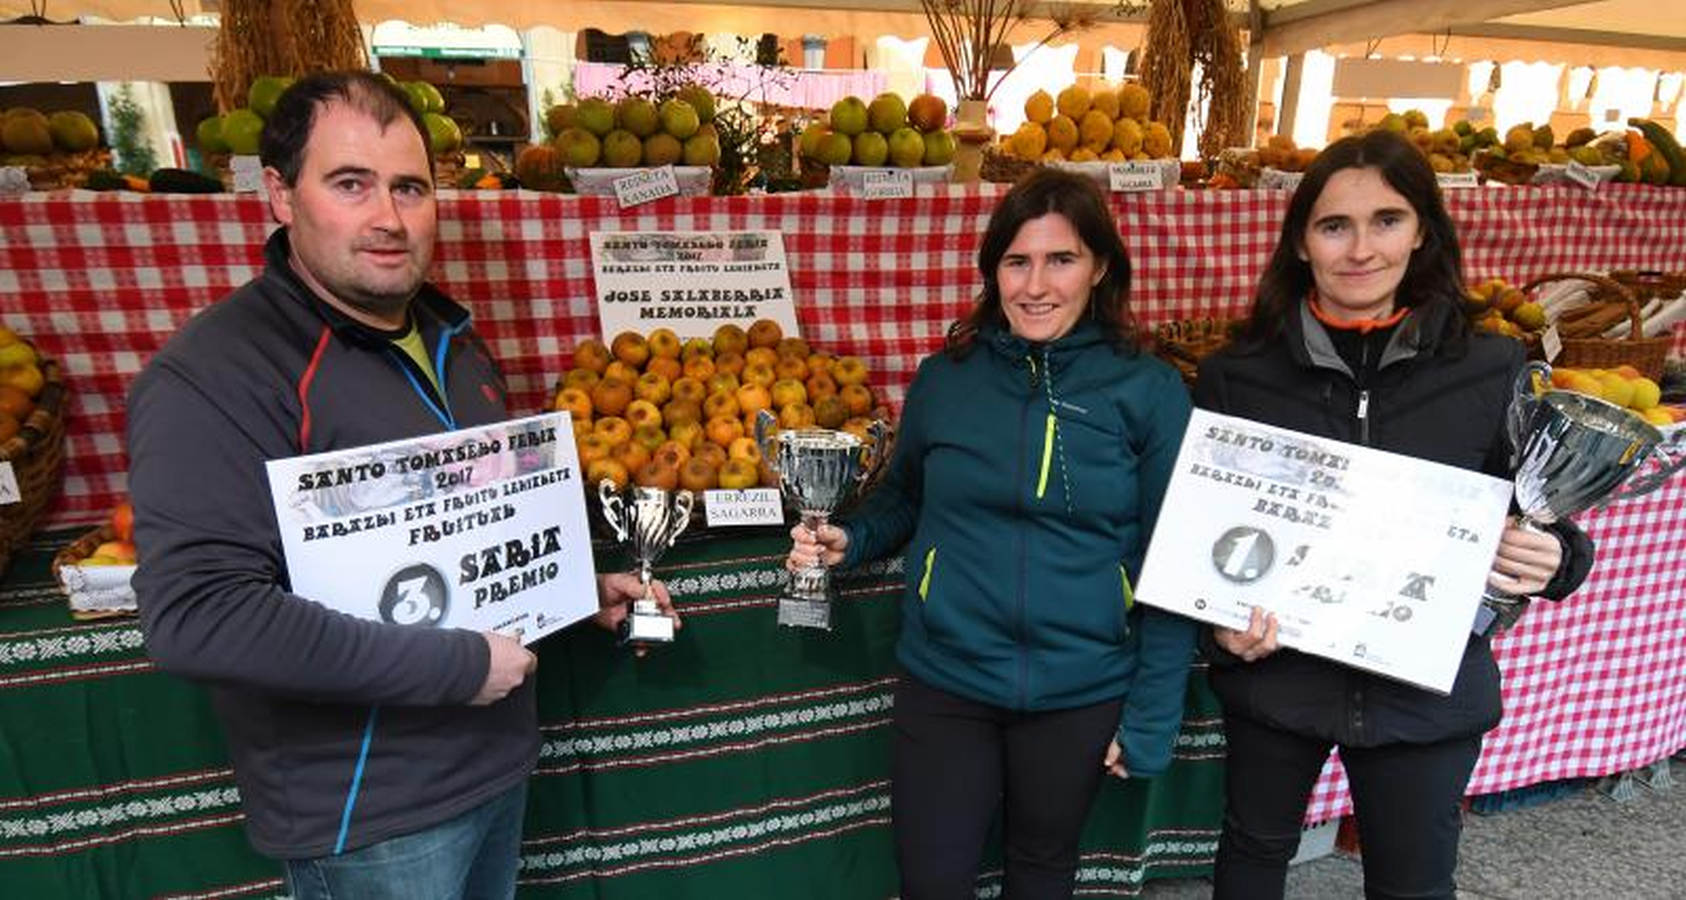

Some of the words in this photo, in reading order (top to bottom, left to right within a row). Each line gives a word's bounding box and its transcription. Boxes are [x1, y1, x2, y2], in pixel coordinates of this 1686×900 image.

[603, 240, 648, 250] SANTO
[655, 264, 675, 272] ETA
[604, 290, 651, 303] JOSE
[660, 287, 785, 302] SALABERRIA
[639, 305, 758, 319] MEMORIALA
[1204, 426, 1274, 453] SANTO
[298, 461, 386, 492] SANTO
[507, 427, 557, 450] FERIA
[435, 466, 474, 489] 2017
[1190, 462, 1262, 492] BARAZKI
[1266, 483, 1300, 501] ETA
[303, 512, 396, 542] BARAZKI
[404, 502, 437, 522] ETA
[443, 488, 498, 512] FRUITU
[710, 508, 777, 520] SAGARRA
[459, 526, 563, 586] SARIA
[1223, 532, 1260, 580] 1.
[391, 575, 441, 626] 3.
[473, 562, 560, 610] PREMIO
